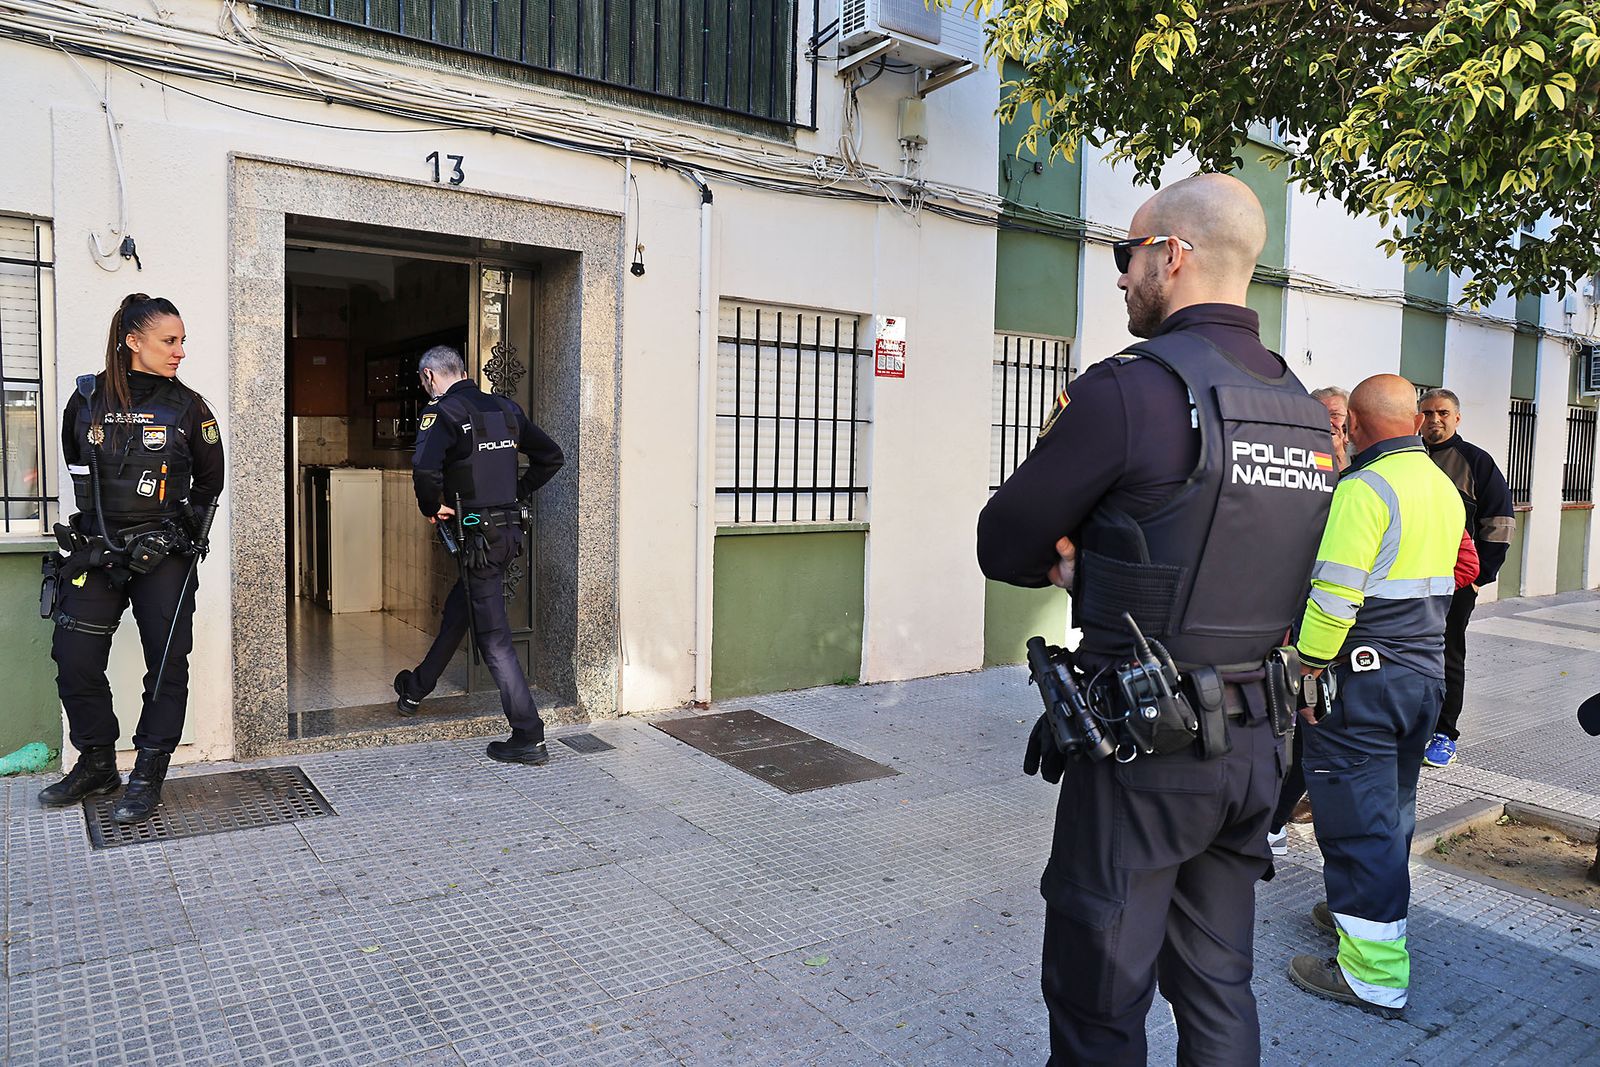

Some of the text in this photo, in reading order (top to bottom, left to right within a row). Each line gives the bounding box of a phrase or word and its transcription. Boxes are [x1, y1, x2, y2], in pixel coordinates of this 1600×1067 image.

[425, 151, 465, 185] 13
[478, 440, 515, 451] POLICIA
[1231, 440, 1318, 469] POLICIA
[1231, 463, 1334, 493] NACIONAL
